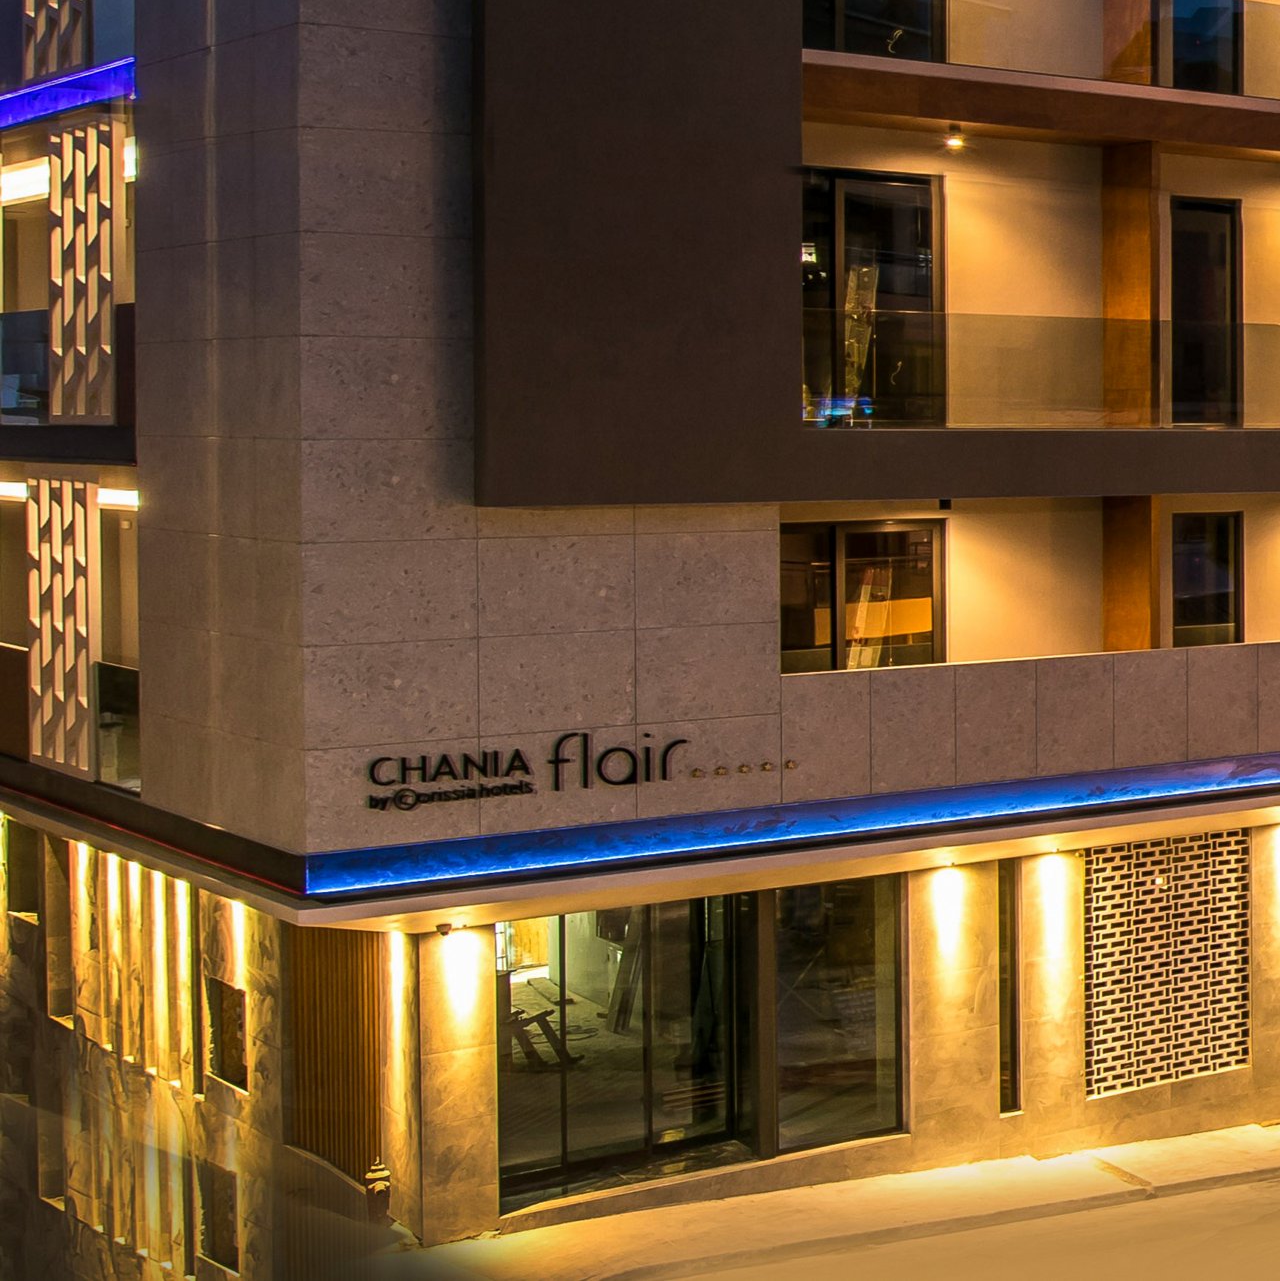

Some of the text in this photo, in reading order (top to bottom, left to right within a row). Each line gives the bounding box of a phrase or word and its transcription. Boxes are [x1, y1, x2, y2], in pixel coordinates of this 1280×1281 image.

[369, 732, 688, 791] CHANIA flair
[368, 794, 392, 811] by
[479, 780, 535, 798] hotels
